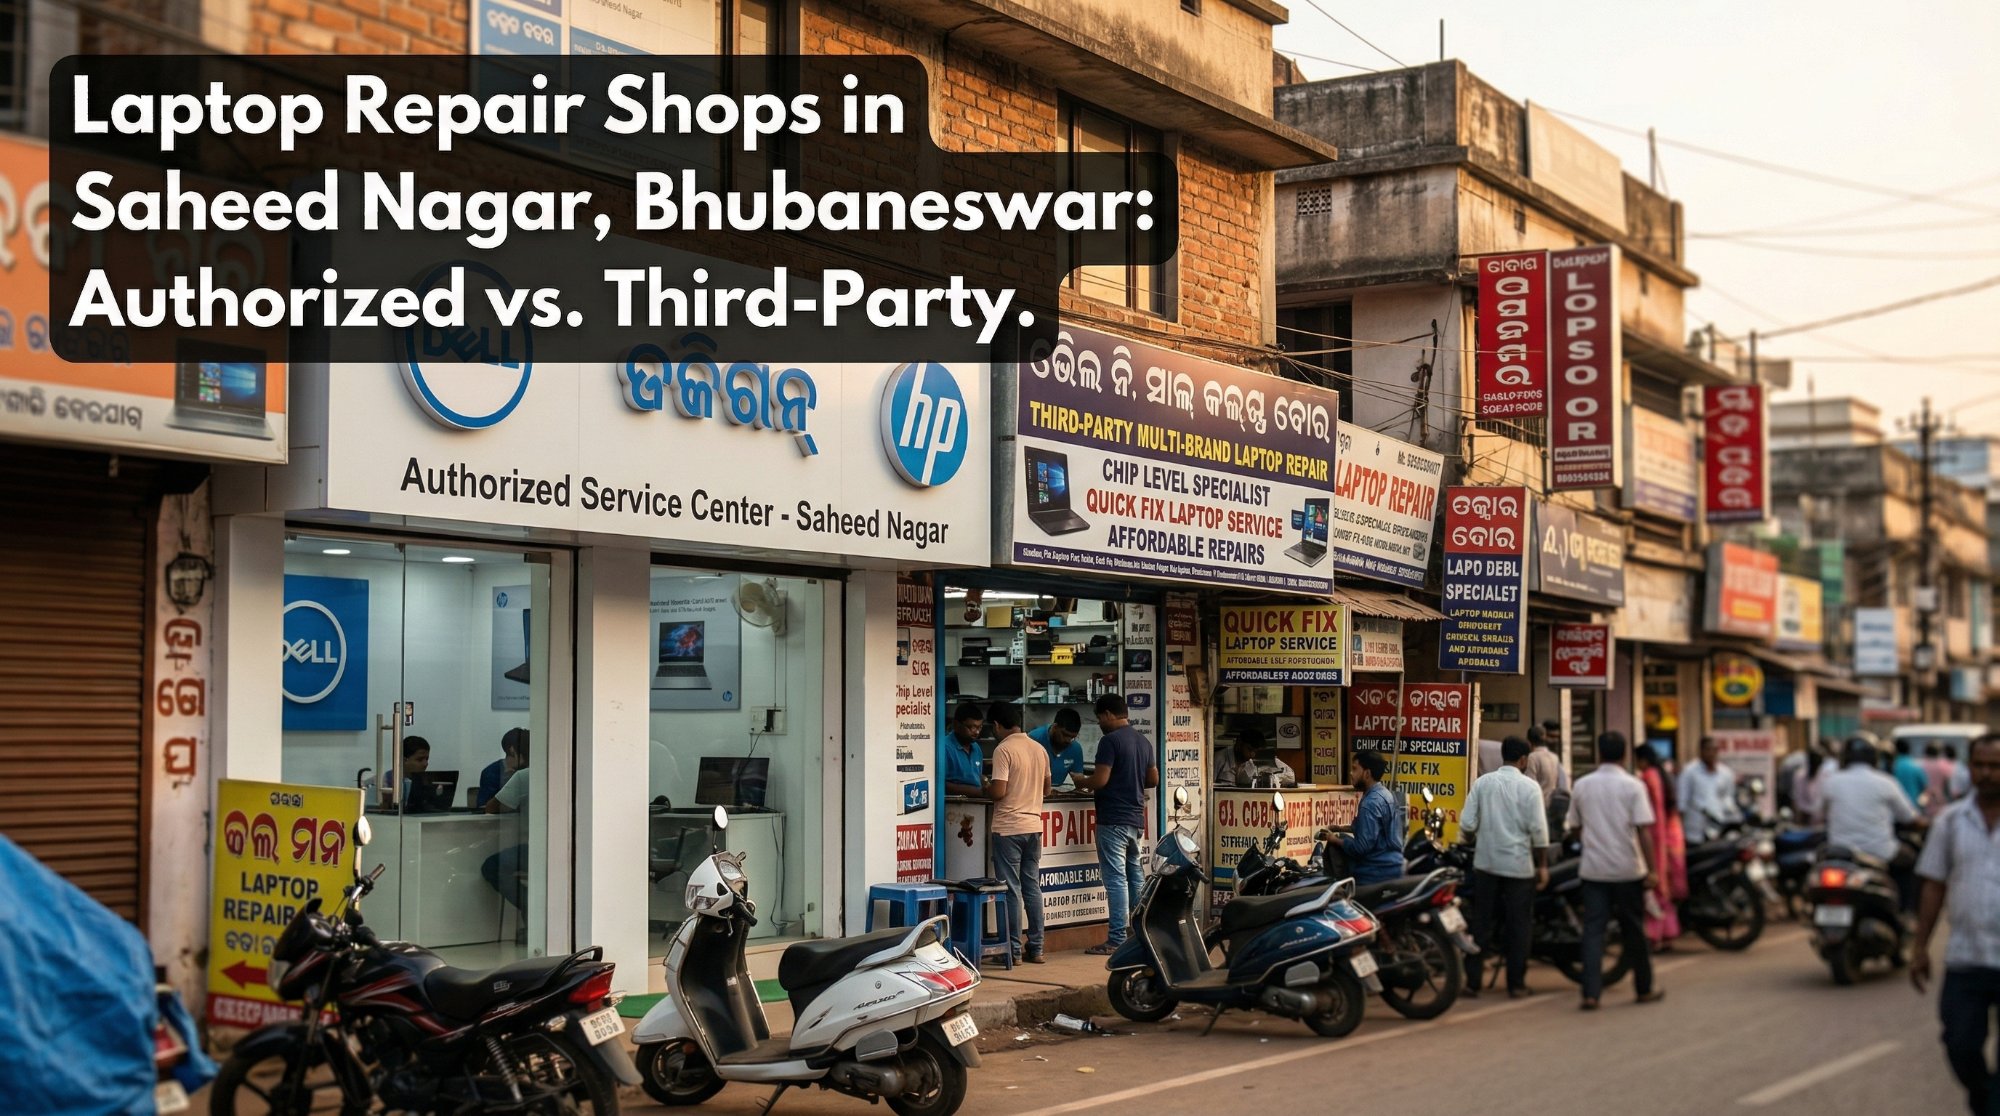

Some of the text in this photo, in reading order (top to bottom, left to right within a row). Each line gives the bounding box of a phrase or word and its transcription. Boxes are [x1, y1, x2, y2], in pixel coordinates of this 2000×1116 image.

[622, 4, 643, 19] Nagar
[897, 361, 962, 487] hp
[1029, 400, 1329, 482] THIRD-PARTY MULTI-BRAND LAPTOP REPAIR
[1102, 458, 1271, 508] CHIP LEVEL SPECIALIST
[1335, 459, 1388, 508] LAPTOP
[1388, 475, 1436, 522] REPAIR
[400, 457, 572, 508] Authorized
[580, 476, 683, 519] Service
[690, 488, 774, 528] Center
[796, 500, 880, 539] Saheed
[887, 510, 949, 549] Nagar
[1086, 488, 1283, 538] QUICK FIX LAPTOP SERVICE
[1107, 524, 1266, 566] AFFORDABLE REPAIRS
[1223, 610, 1338, 634] QUICK FIX
[1450, 608, 1480, 618] LAPTOP
[282, 637, 339, 664] DELL
[1225, 636, 1337, 650] LAPTOP SERVICE
[1448, 644, 1466, 653] AND
[912, 685, 933, 698] Level
[1354, 714, 1461, 733] LAPTOP REPAIR
[1410, 741, 1461, 754] SPECIALIST
[1421, 762, 1440, 776] FIX
[241, 871, 319, 901] LAPTOP
[223, 897, 299, 927] REPAIR
